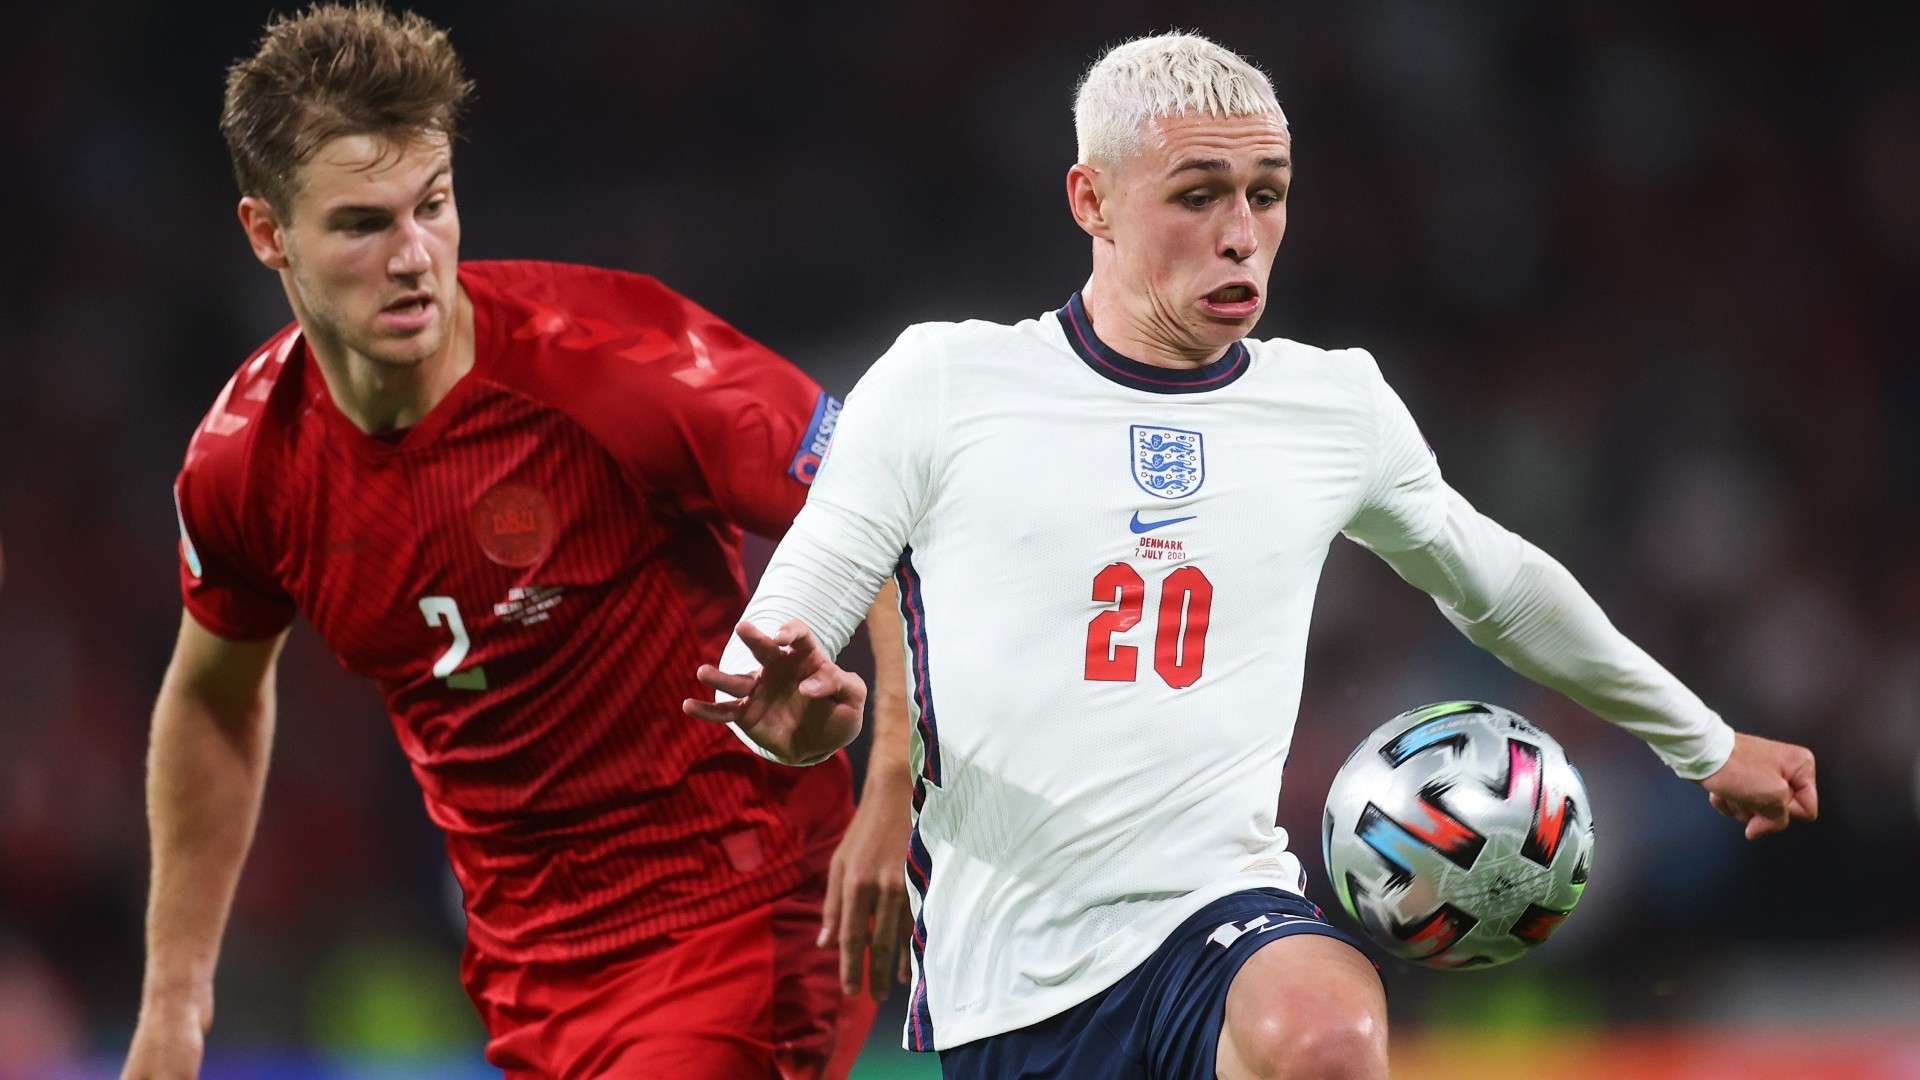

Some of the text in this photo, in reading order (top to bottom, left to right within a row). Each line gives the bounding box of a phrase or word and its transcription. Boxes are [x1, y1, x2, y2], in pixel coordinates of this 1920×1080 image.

[1140, 537, 1183, 550] DENMARK
[1142, 550, 1163, 560] JULY
[419, 596, 487, 690] 2
[1084, 562, 1213, 689] 20
